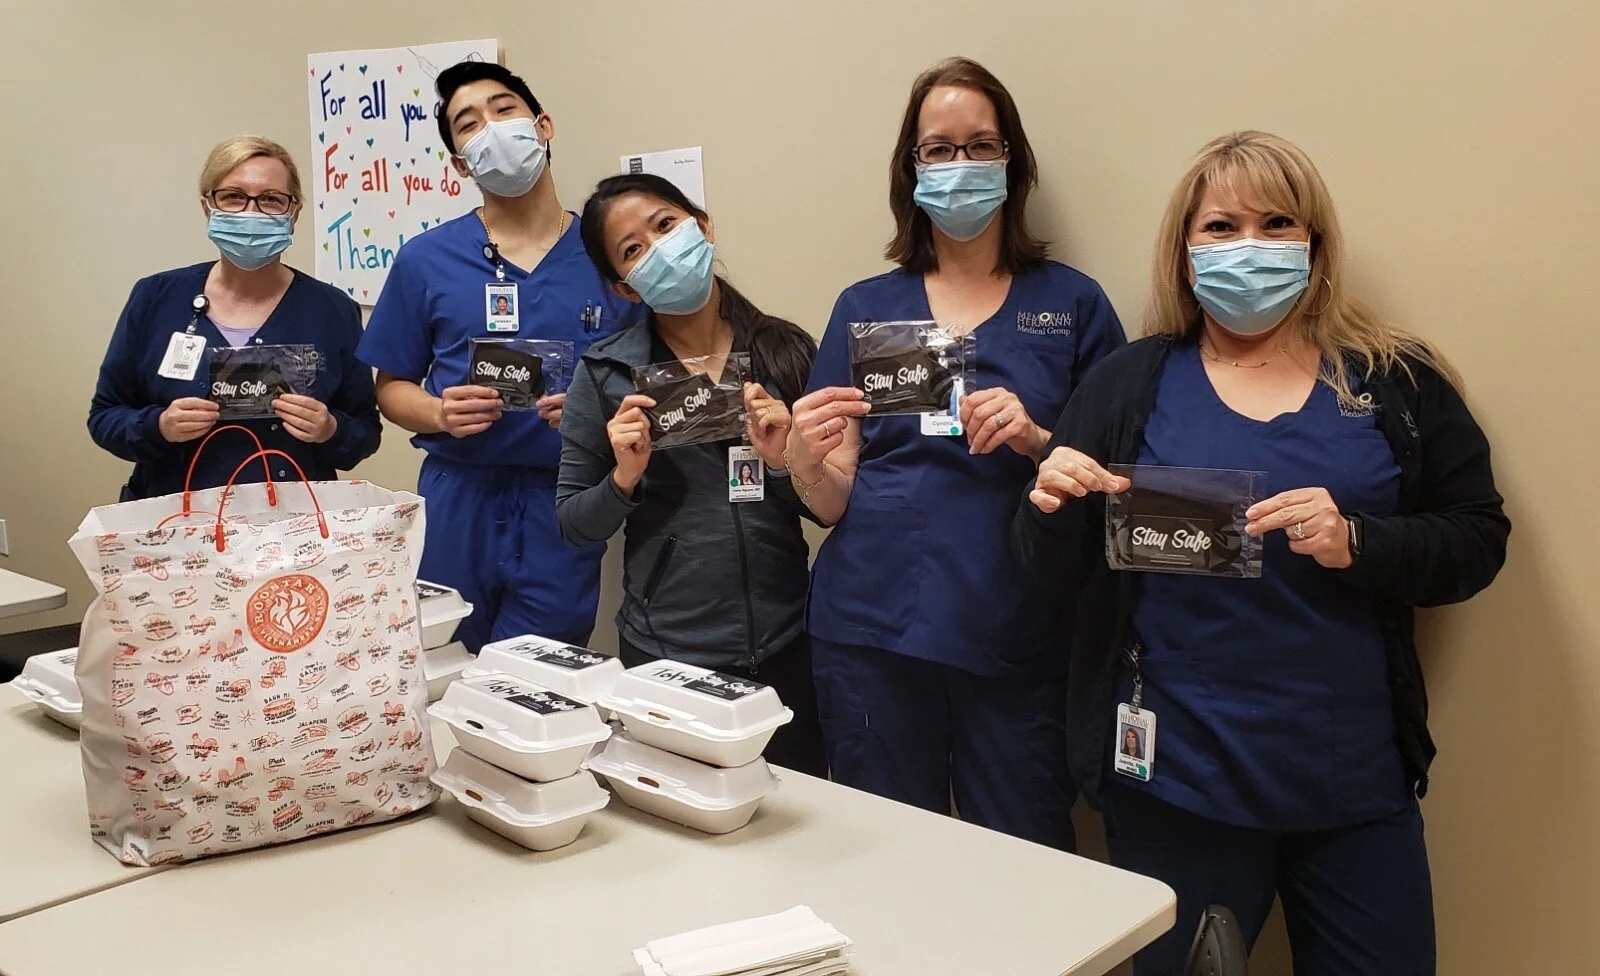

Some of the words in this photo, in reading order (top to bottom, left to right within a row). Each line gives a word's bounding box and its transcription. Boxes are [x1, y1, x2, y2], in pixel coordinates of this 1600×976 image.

[320, 70, 346, 122] For
[358, 79, 386, 120] all
[400, 103, 427, 142] you
[325, 143, 349, 193] For
[361, 157, 389, 193] all
[403, 172, 433, 206] you
[440, 164, 461, 197] do
[328, 211, 403, 271] Than
[1017, 311, 1072, 321] MEMORIAL
[1017, 318, 1071, 327] HERMANN
[1017, 325, 1045, 335] Medical
[1047, 327, 1070, 336] Group
[476, 361, 502, 380] Stay
[503, 365, 531, 382] Safe
[864, 373, 893, 392] Stay
[897, 364, 928, 385] Safe
[212, 381, 237, 397] Stay
[240, 381, 267, 397] Safe
[659, 407, 686, 431] Stay
[684, 388, 711, 412] Safe
[1132, 526, 1168, 550] Stay
[1171, 529, 1212, 552] Safe
[653, 667, 693, 684] Tofu
